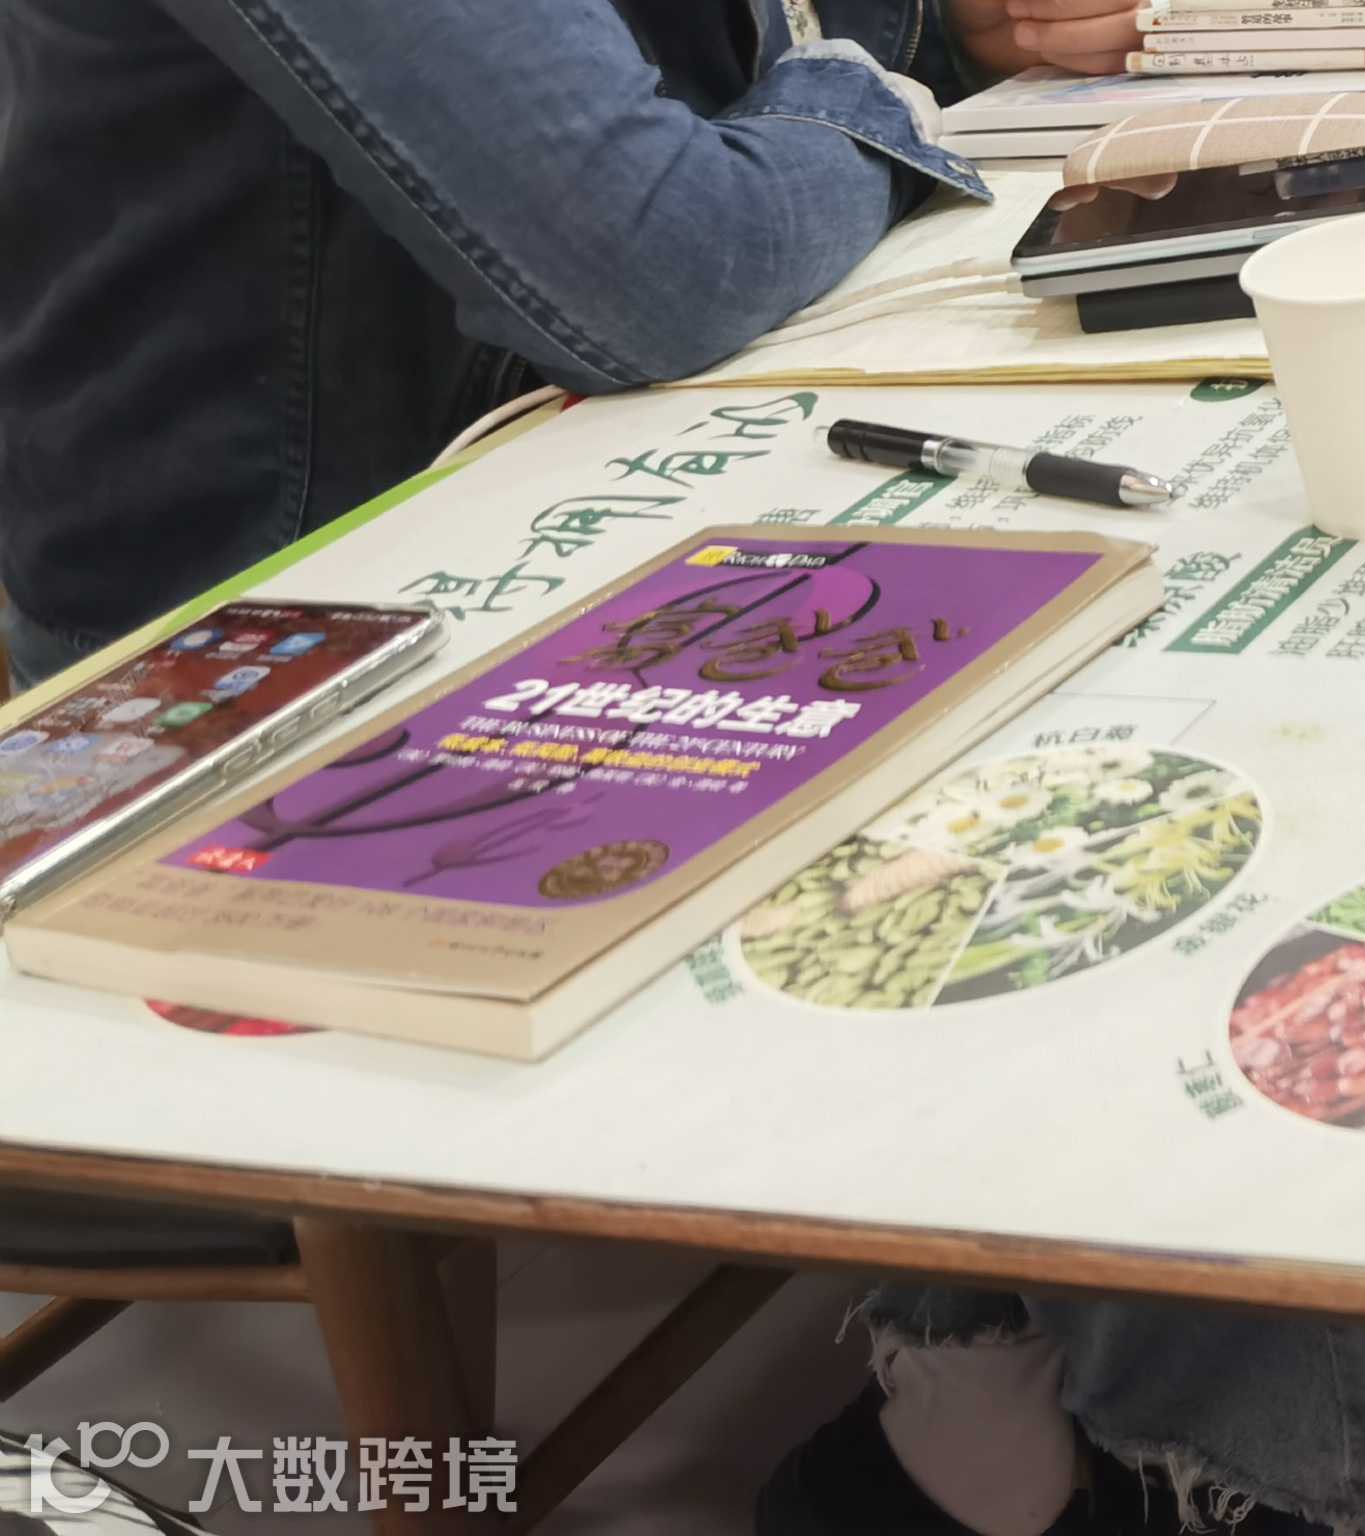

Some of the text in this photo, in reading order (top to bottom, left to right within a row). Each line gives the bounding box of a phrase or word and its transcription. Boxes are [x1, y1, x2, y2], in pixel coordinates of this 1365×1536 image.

[1190, 533, 1345, 649] 脂肪清洁员
[483, 677, 861, 739] 21世纪的生意
[1032, 723, 1138, 749] 杭白菊
